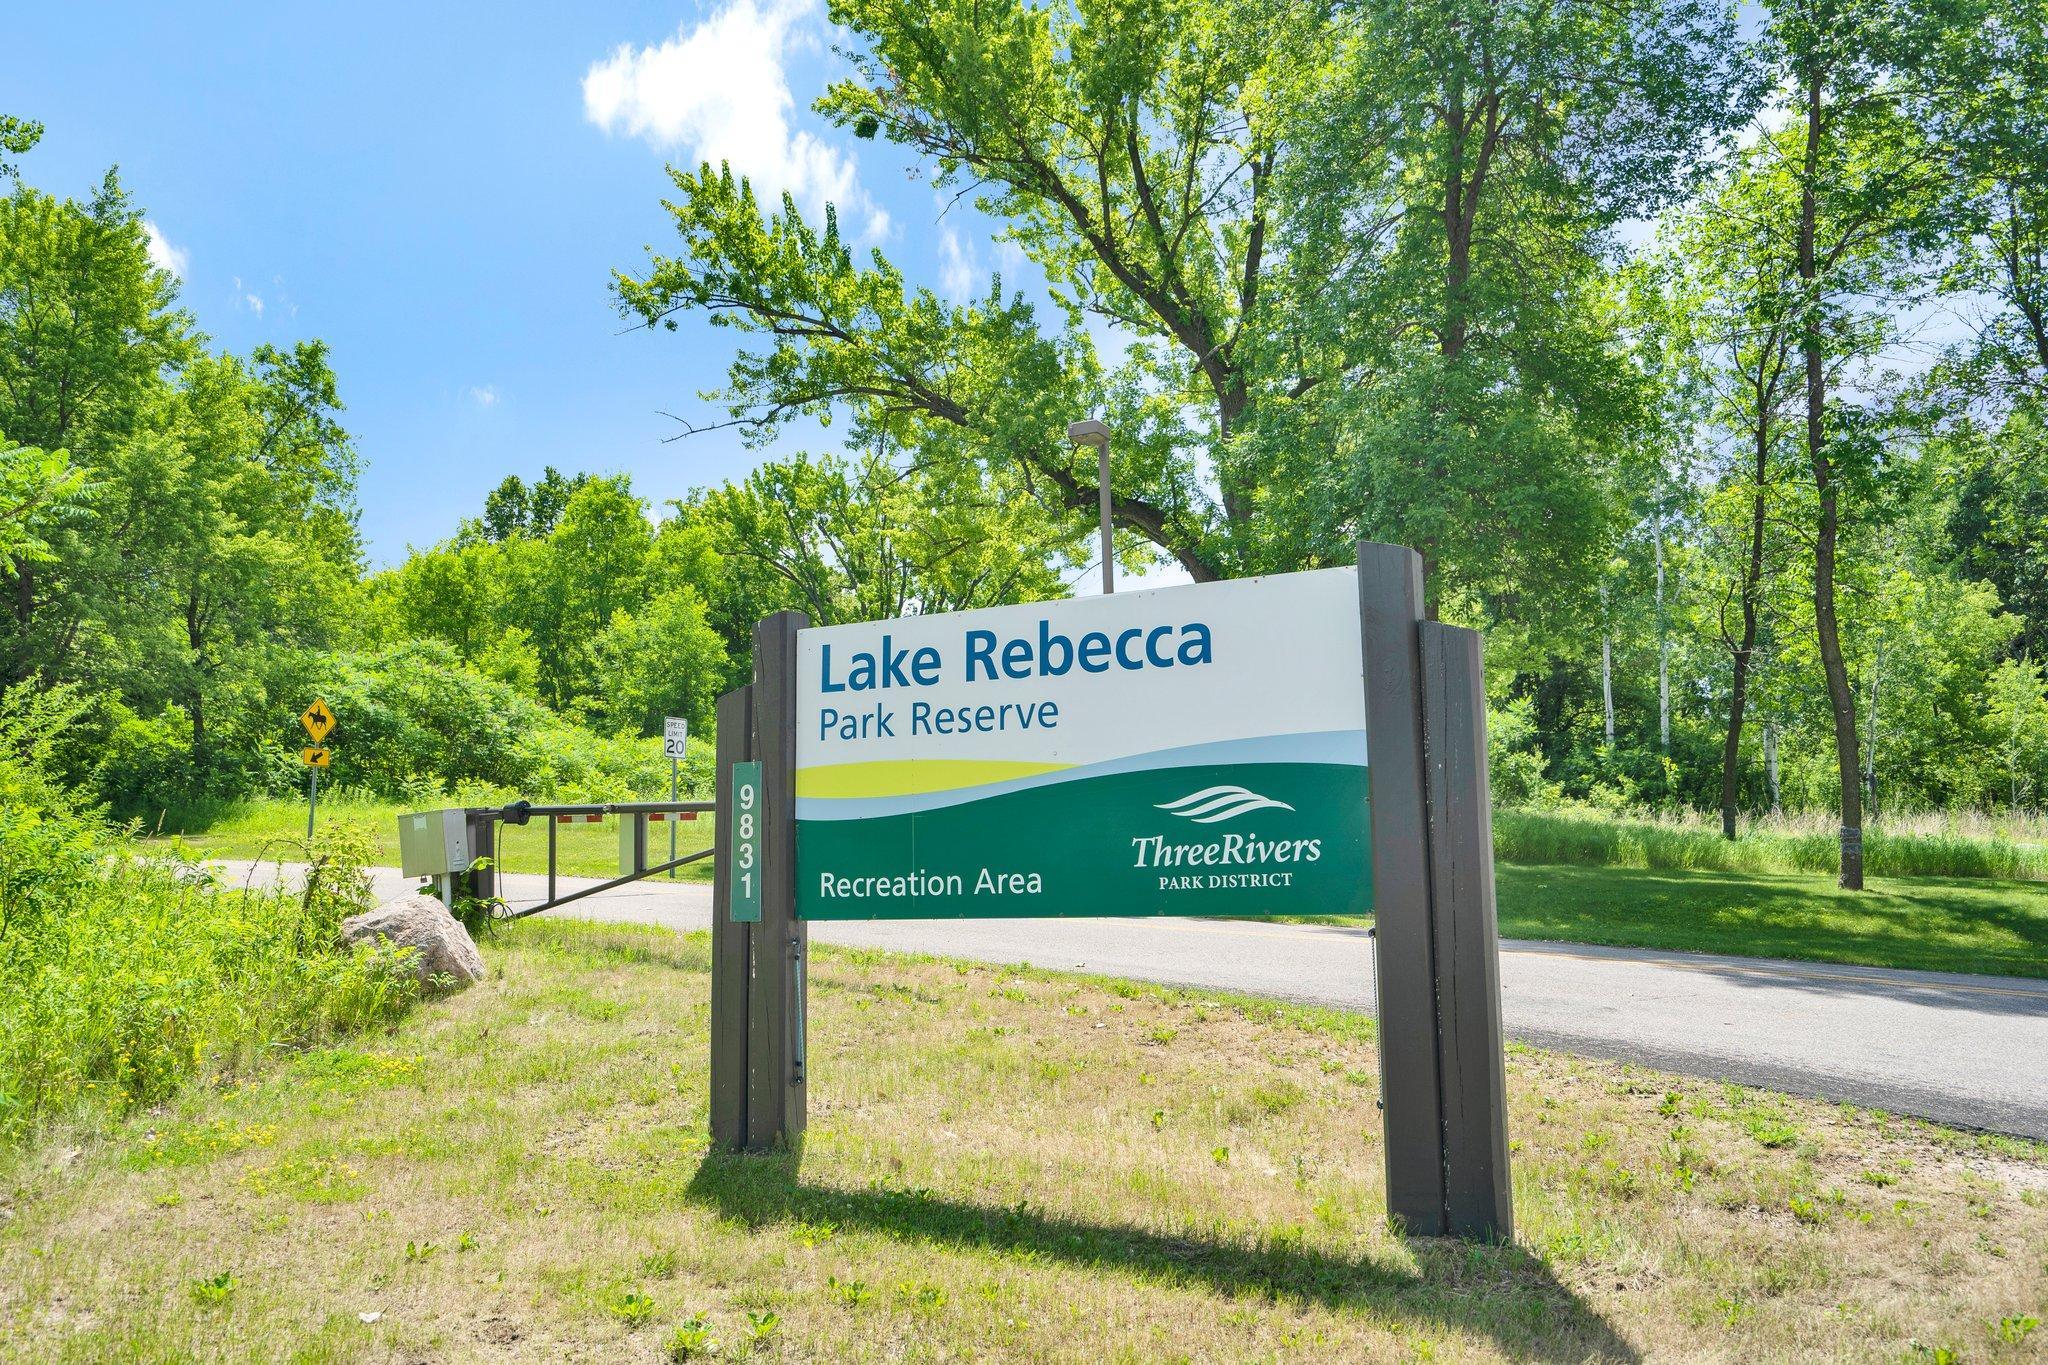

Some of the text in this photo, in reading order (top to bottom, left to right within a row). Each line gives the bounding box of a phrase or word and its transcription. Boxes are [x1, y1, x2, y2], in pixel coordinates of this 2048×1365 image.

[821, 618, 1213, 694] Lake Rebecca
[666, 721, 686, 729] SPEED
[820, 700, 1059, 742] Park Reserve
[666, 738, 685, 755] 20
[739, 783, 755, 899] 9831
[1131, 832, 1322, 868] ThreeRivers
[820, 868, 1042, 898] Recreation Area
[1159, 873, 1292, 890] PARK DISTRICT
